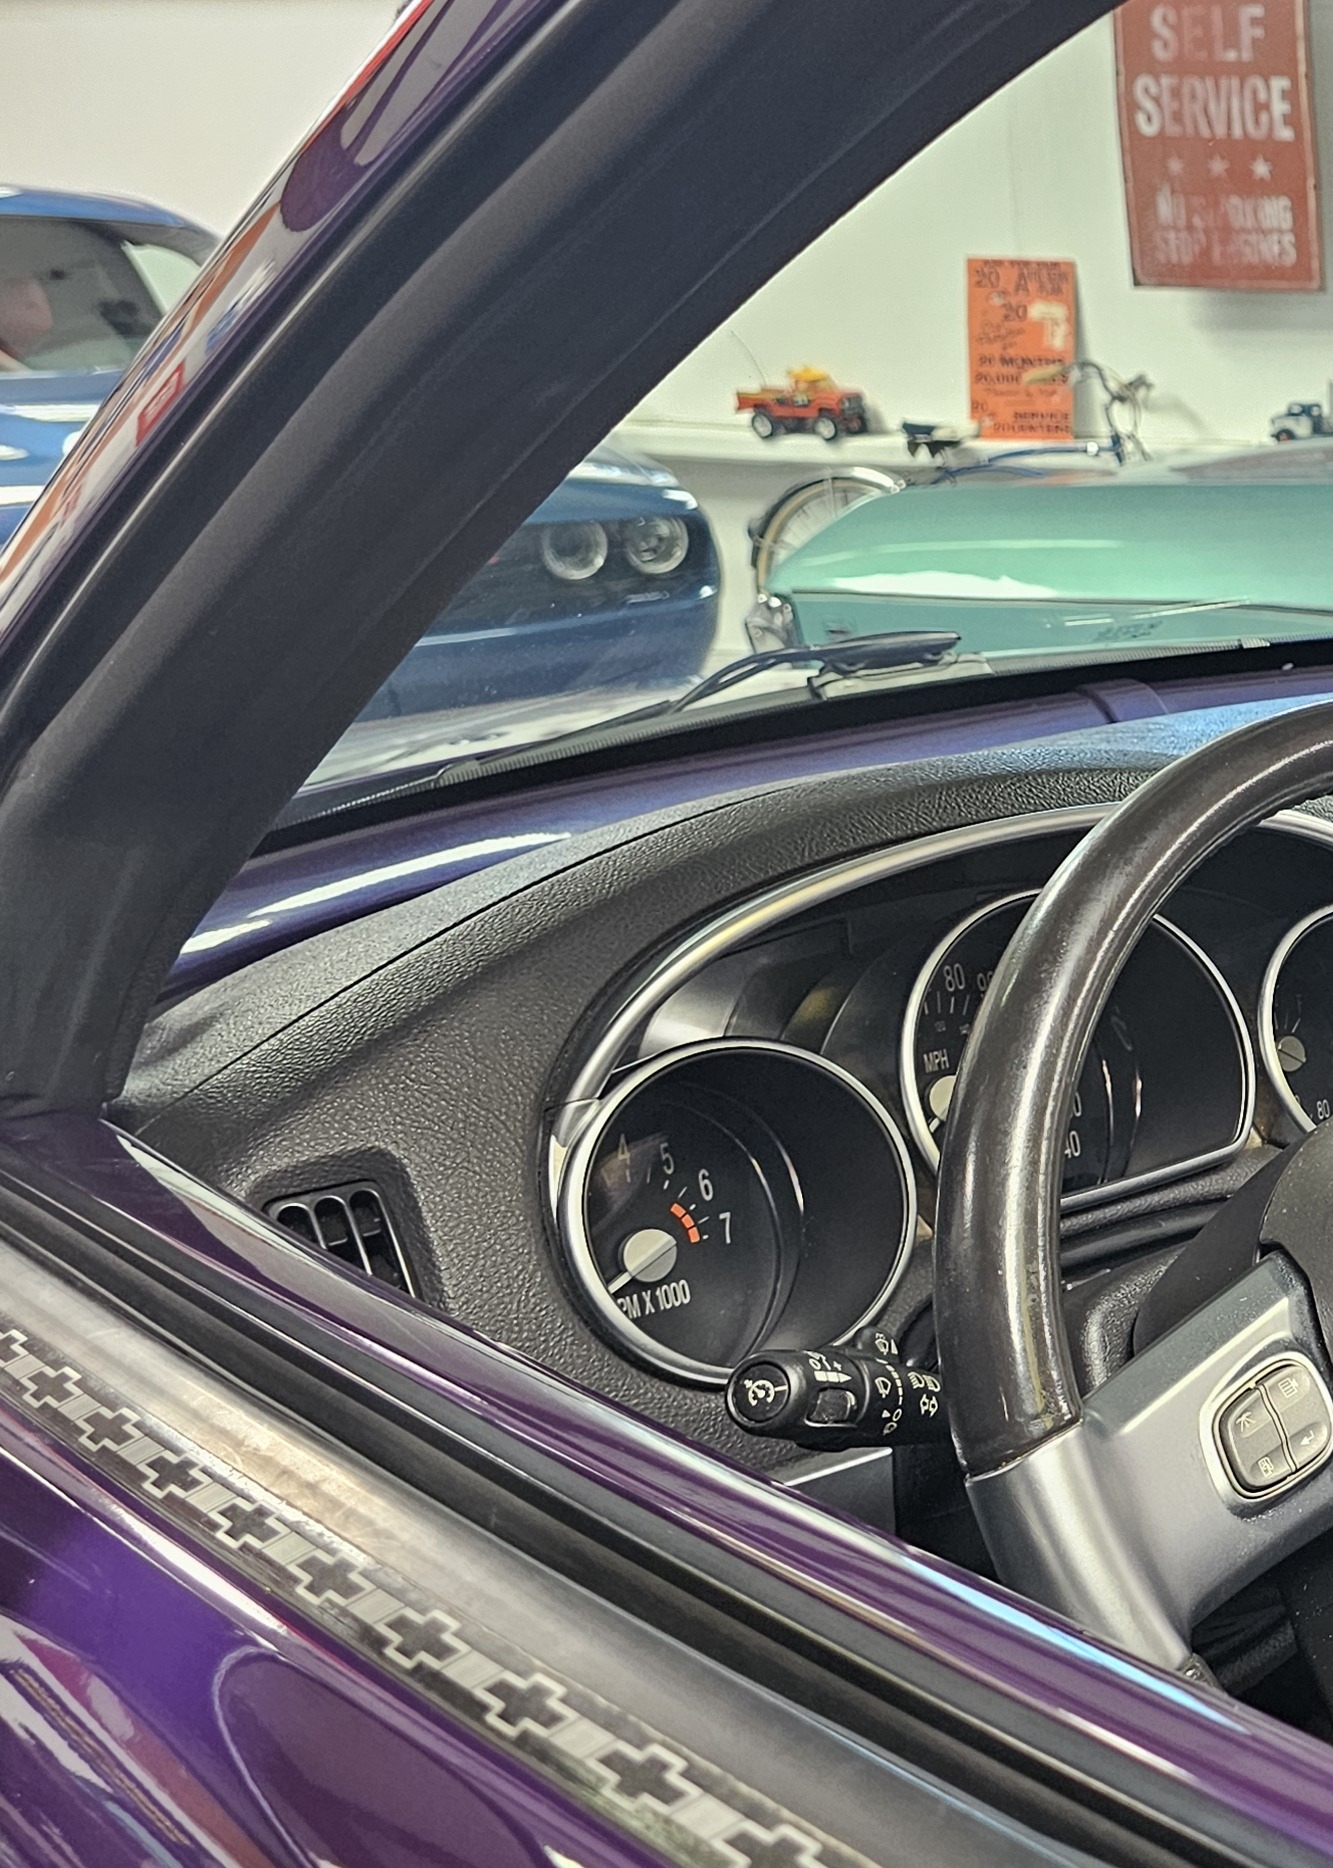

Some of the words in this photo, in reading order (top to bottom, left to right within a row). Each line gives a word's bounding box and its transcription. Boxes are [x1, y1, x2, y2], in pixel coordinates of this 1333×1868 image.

[1151, 4, 1266, 63] SELF
[1132, 71, 1296, 142] SERVICE
[943, 963, 966, 992] 80
[923, 1049, 950, 1074] MPH
[1316, 1099, 1331, 1120] 80
[617, 1134, 631, 1165] 4
[660, 1142, 675, 1175] 5
[698, 1168, 714, 1202] 6
[719, 1211, 732, 1245] 7
[643, 1289, 656, 1316] X
[655, 1279, 691, 1311] 1000
